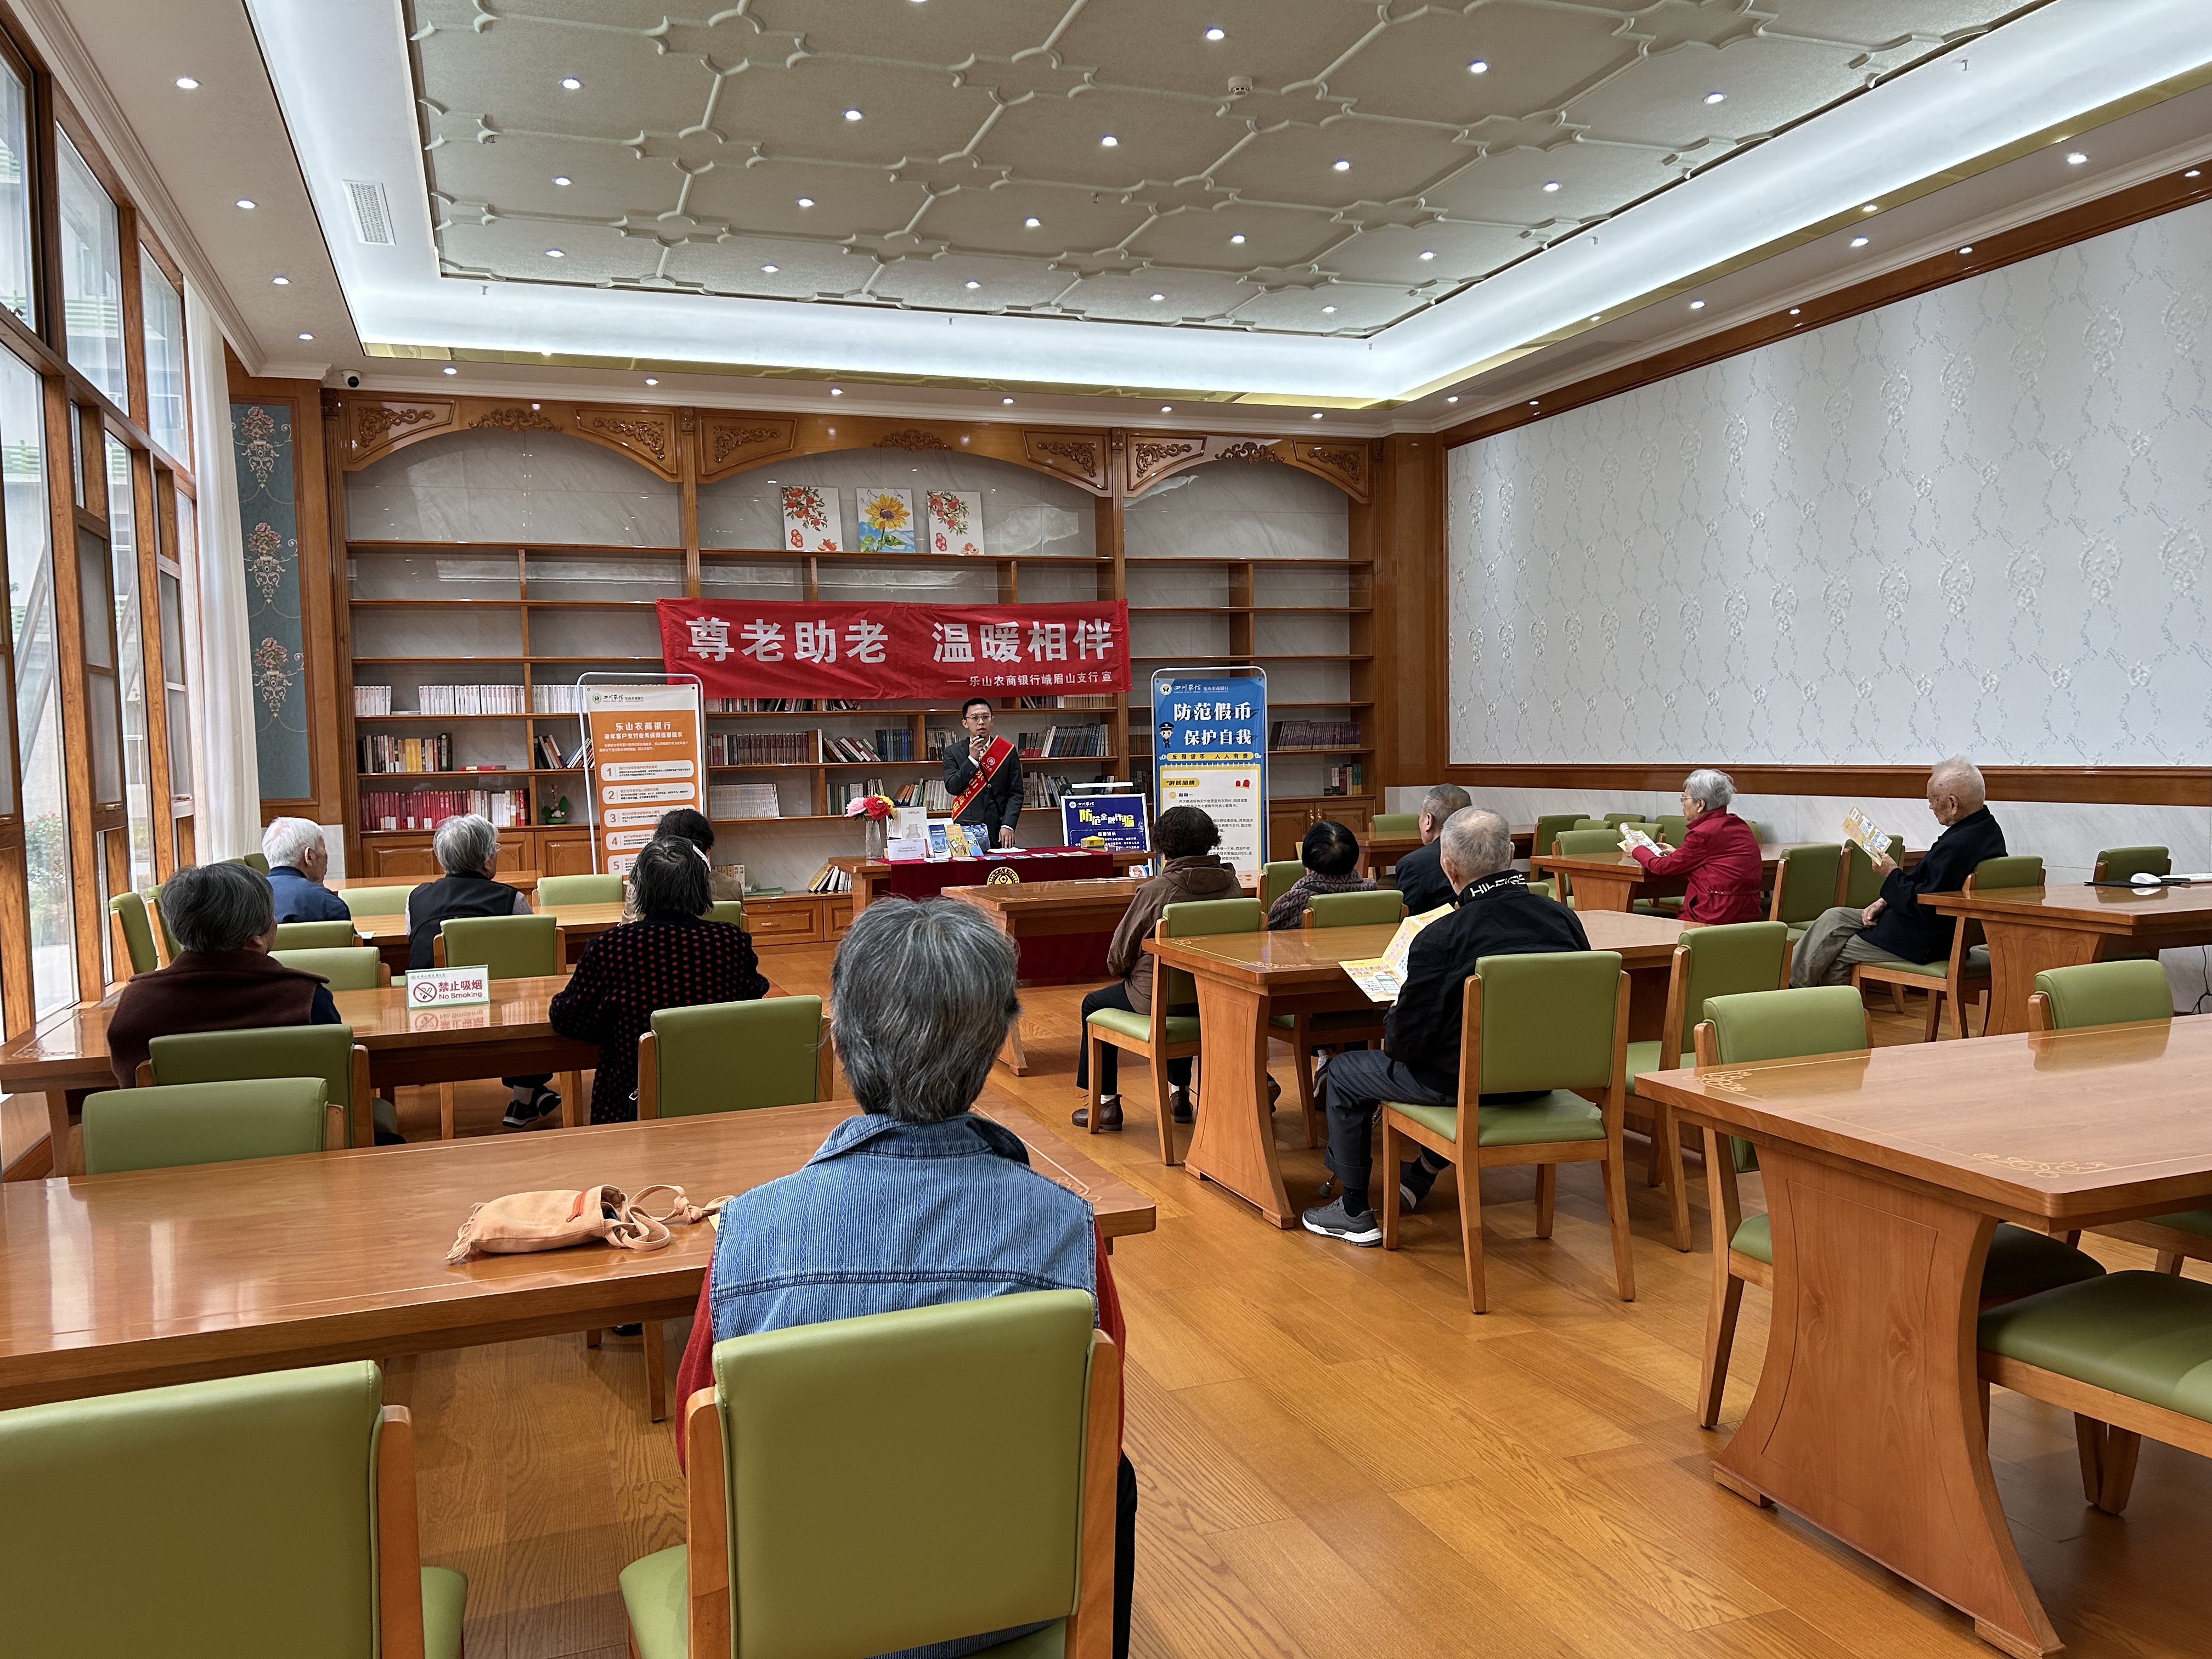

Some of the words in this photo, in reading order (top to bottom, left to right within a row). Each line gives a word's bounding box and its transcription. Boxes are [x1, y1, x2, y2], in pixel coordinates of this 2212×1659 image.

[685, 616, 888, 664] 尊老助老
[932, 618, 1114, 663] 温暖相伴
[1101, 671, 1113, 682] 宣
[1174, 702, 1251, 721] 防范假币
[616, 721, 672, 731] 乐山农商银行
[1184, 729, 1251, 746] 保护自我
[606, 768, 612, 777] 1
[608, 791, 614, 800] 2
[610, 814, 617, 823] 3
[1079, 809, 1135, 827] 防范金融诈骗
[611, 837, 618, 845] 4
[613, 861, 619, 870] 5
[438, 979, 482, 992] 禁止吸烟
